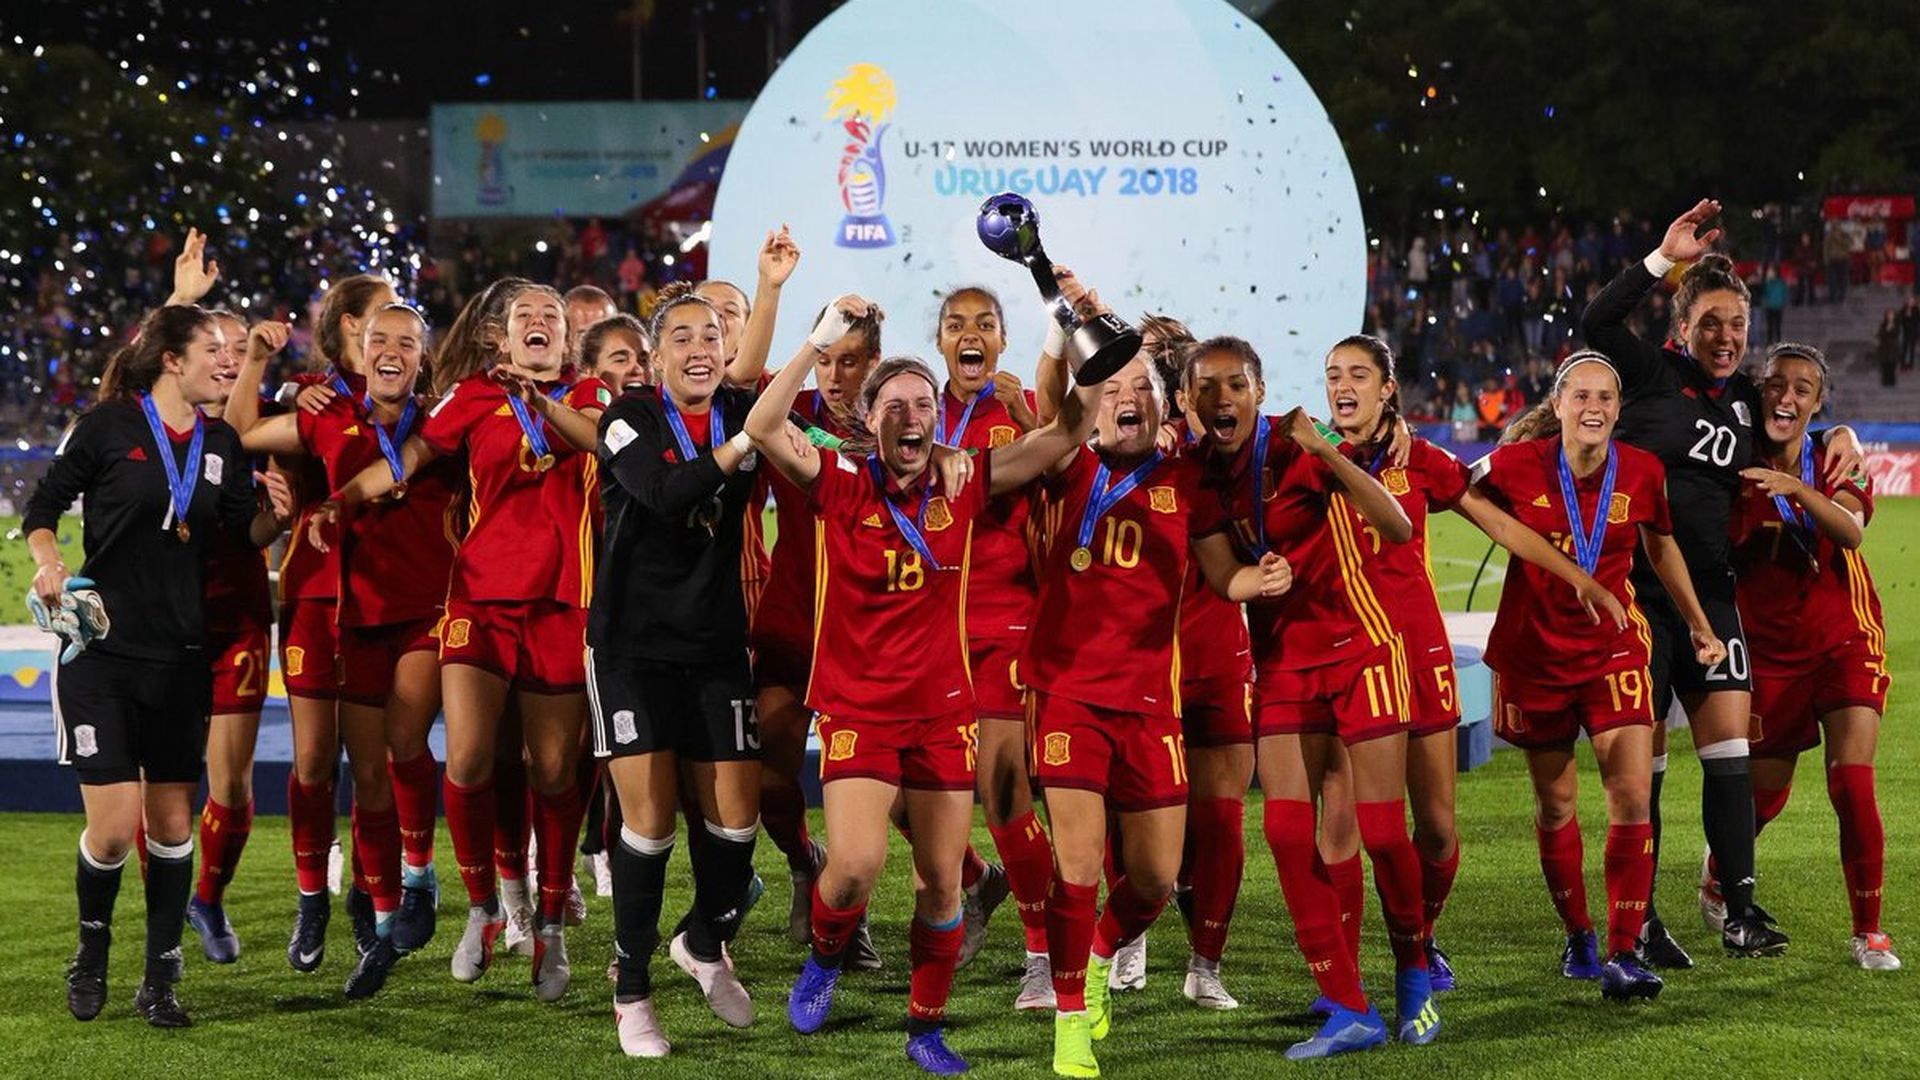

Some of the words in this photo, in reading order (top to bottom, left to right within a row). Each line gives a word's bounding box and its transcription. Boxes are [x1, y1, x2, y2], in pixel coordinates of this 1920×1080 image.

[963, 140, 1082, 158] WOMEN'S
[1089, 140, 1176, 158] WORLD
[1182, 140, 1229, 158] CUP
[935, 164, 1107, 197] URUGUAY
[1118, 167, 1198, 196] 2018
[845, 223, 888, 241] FIFA
[1688, 418, 1737, 467] 20
[1103, 516, 1143, 569] 10
[883, 549, 924, 592] 18
[1363, 664, 1393, 718] 11
[1434, 664, 1453, 712] 5
[1604, 669, 1643, 712] 19
[730, 698, 761, 751] 13
